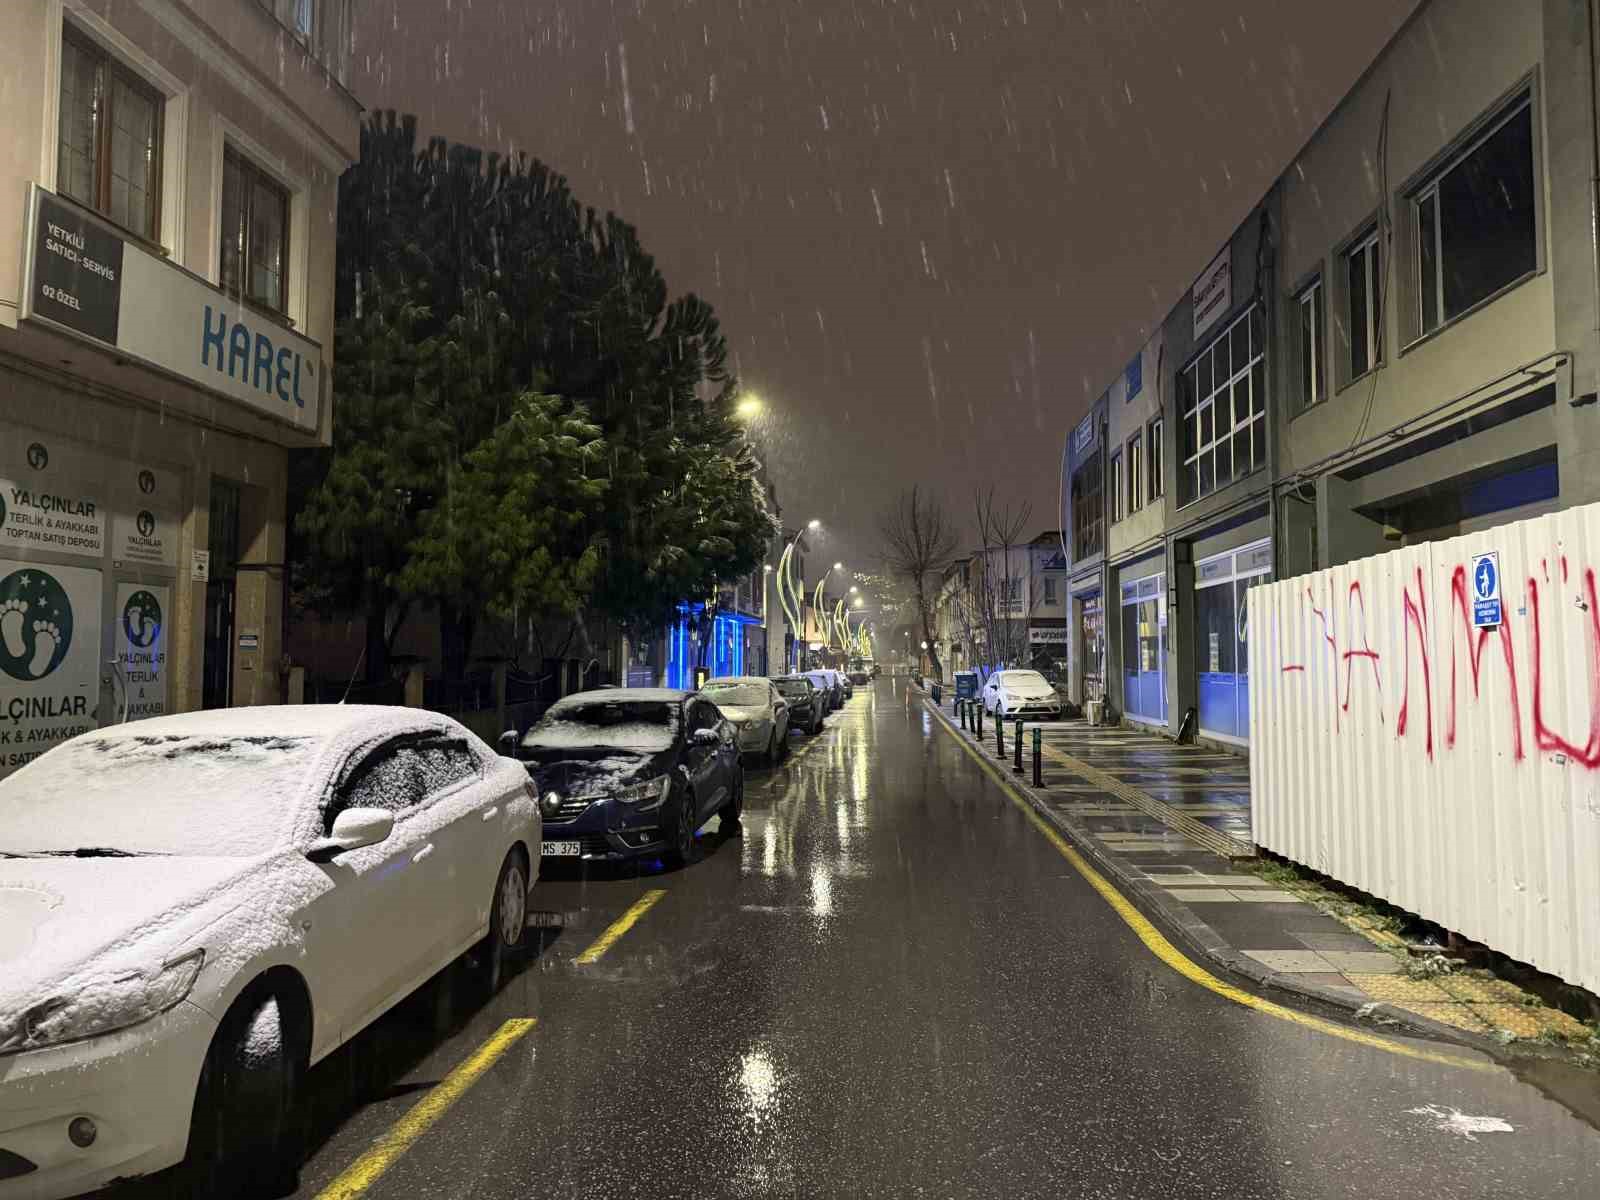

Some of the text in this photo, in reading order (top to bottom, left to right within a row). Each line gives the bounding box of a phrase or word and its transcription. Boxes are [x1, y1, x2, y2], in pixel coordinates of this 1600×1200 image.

[201, 304, 305, 409] KAREL
[10, 487, 96, 519] YALÇINLAR
[46, 518, 53, 528] &
[6, 527, 41, 541] TOPTAN
[67, 536, 100, 549] DEPOSU
[15, 729, 23, 743] &
[560, 842, 579, 855] 375
